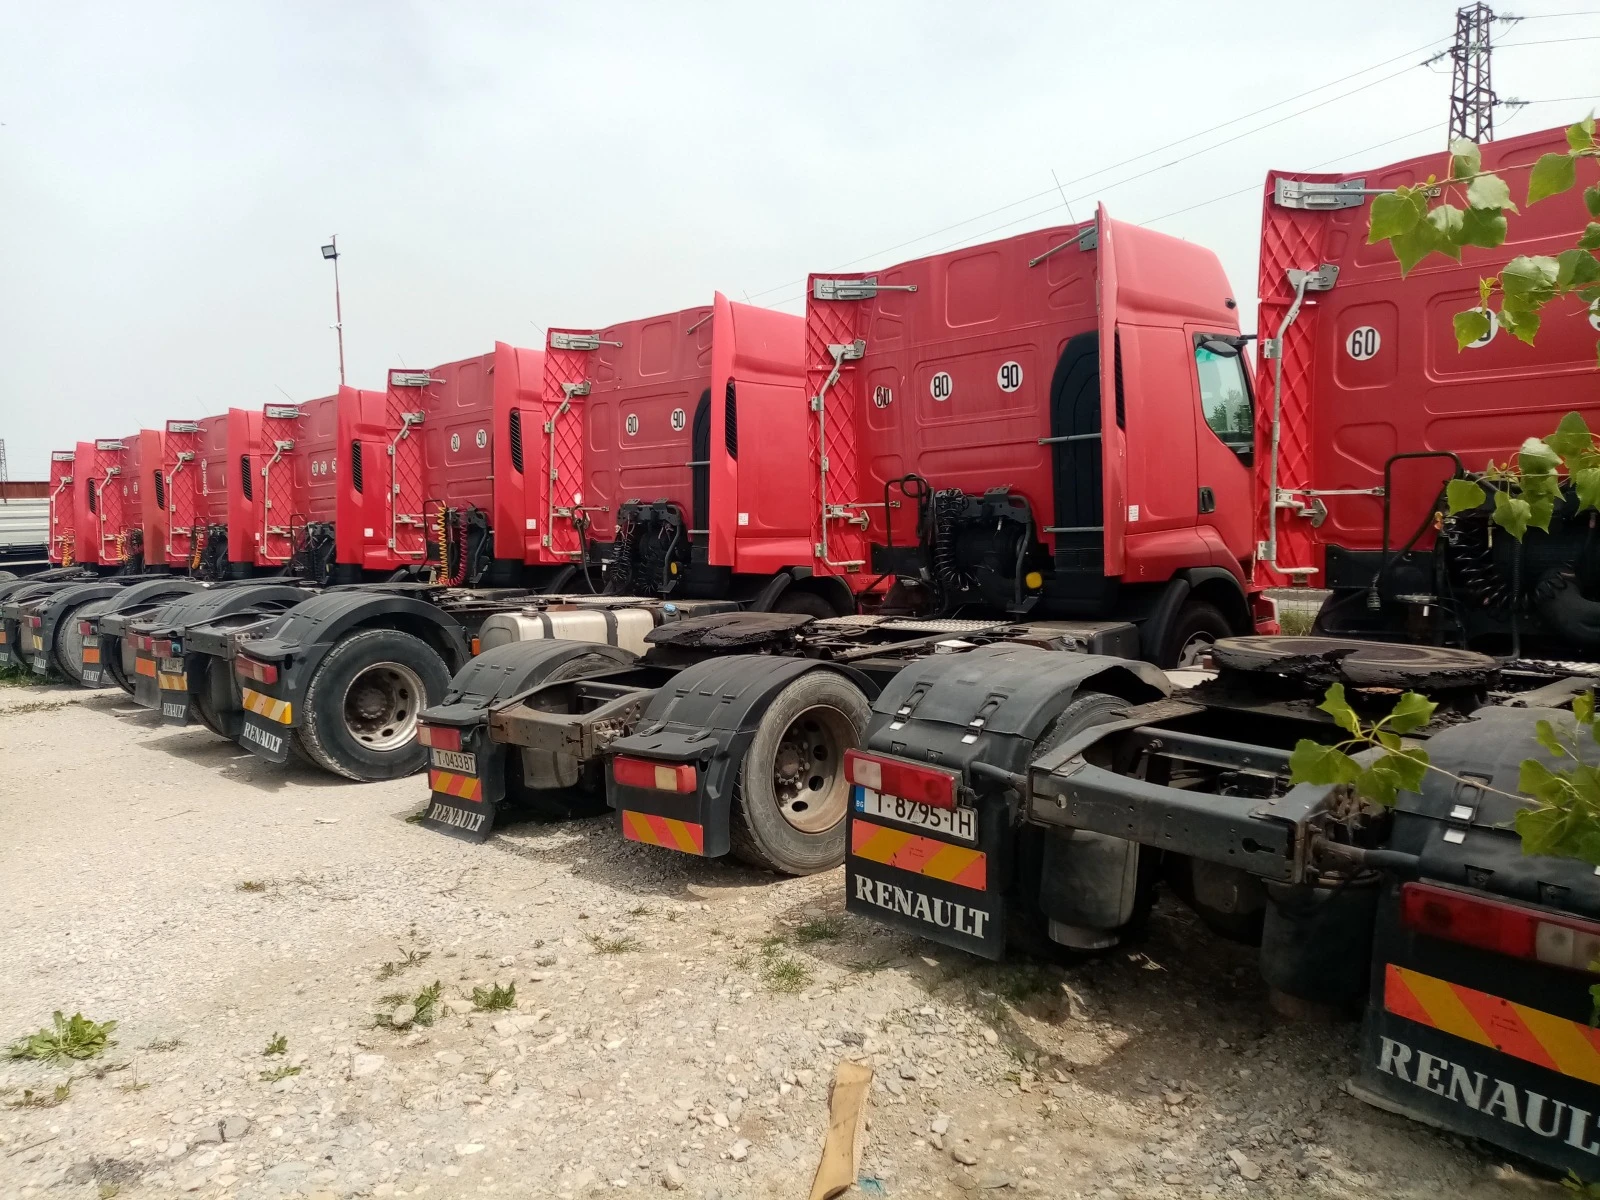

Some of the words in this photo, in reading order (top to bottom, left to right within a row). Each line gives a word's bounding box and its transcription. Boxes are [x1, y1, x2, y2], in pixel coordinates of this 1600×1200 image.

[1351, 328, 1376, 358] 60
[933, 375, 949, 398] 80
[1001, 364, 1019, 389] 90
[628, 416, 637, 433] 80
[673, 411, 684, 428] 90
[163, 703, 186, 718] RENAULT
[243, 722, 282, 753] RENAULT
[429, 803, 485, 832] RENAULT
[854, 874, 989, 939] RENAULT
[1377, 1035, 1600, 1156] RENAUL
